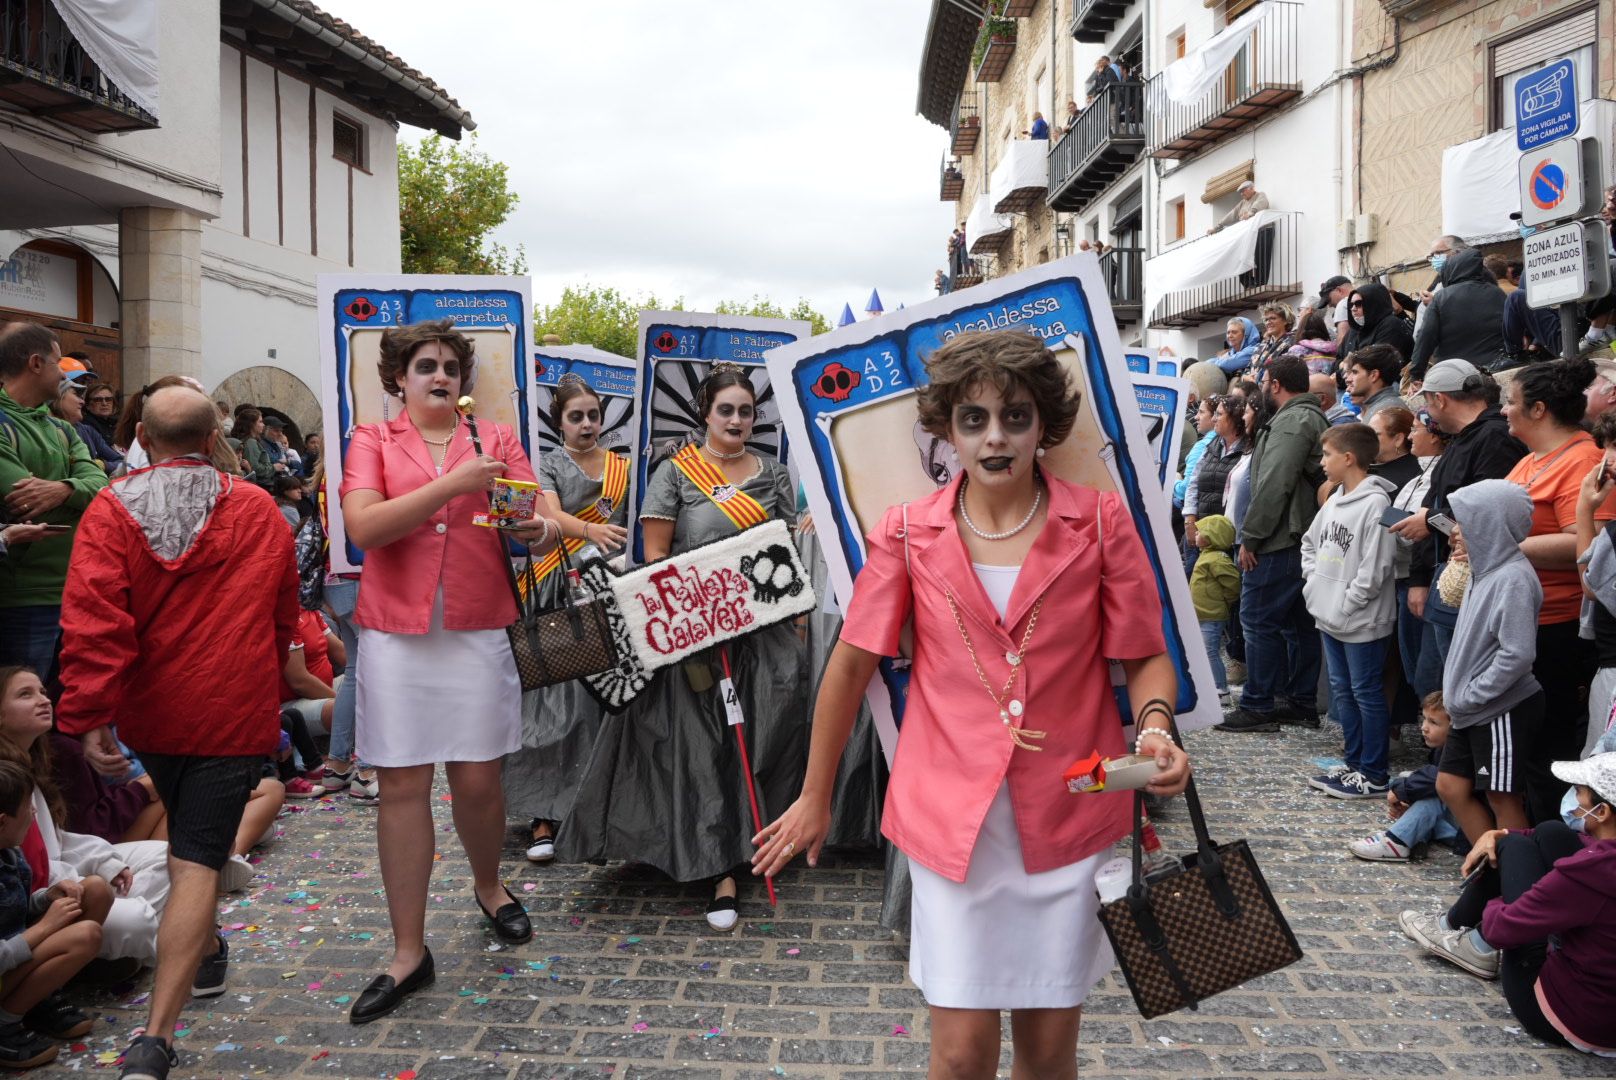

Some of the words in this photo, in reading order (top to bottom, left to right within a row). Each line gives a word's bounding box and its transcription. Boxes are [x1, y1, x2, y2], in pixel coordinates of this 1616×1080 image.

[1521, 124, 1539, 136] ZONA
[1540, 112, 1571, 128] VIGILADA
[1525, 134, 1538, 144] POR
[1527, 239, 1551, 255] ZONA
[1554, 232, 1579, 247] AZUL
[1528, 247, 1580, 269] AUTORIZADOS
[1530, 273, 1539, 281] 30
[1541, 269, 1557, 279] MIN.
[1560, 263, 1579, 274] MAX.
[380, 301, 389, 310] A
[393, 300, 401, 310] 3
[435, 297, 508, 308] alcaldessa
[381, 311, 391, 322] D
[943, 297, 1061, 341] alcaldessa
[680, 336, 687, 344] A
[690, 335, 695, 343] 7
[730, 335, 740, 345] la
[744, 336, 783, 348] Fallera
[680, 346, 687, 354] D
[690, 346, 695, 354] 7
[733, 349, 763, 359] Calav
[864, 358, 879, 375] A
[881, 352, 894, 368] 3
[548, 372, 554, 380] D
[593, 368, 602, 377] la
[866, 375, 883, 394] D
[890, 369, 902, 386] 2
[635, 592, 661, 616] la
[648, 564, 749, 624] Fallera
[645, 596, 754, 655] Calavera
